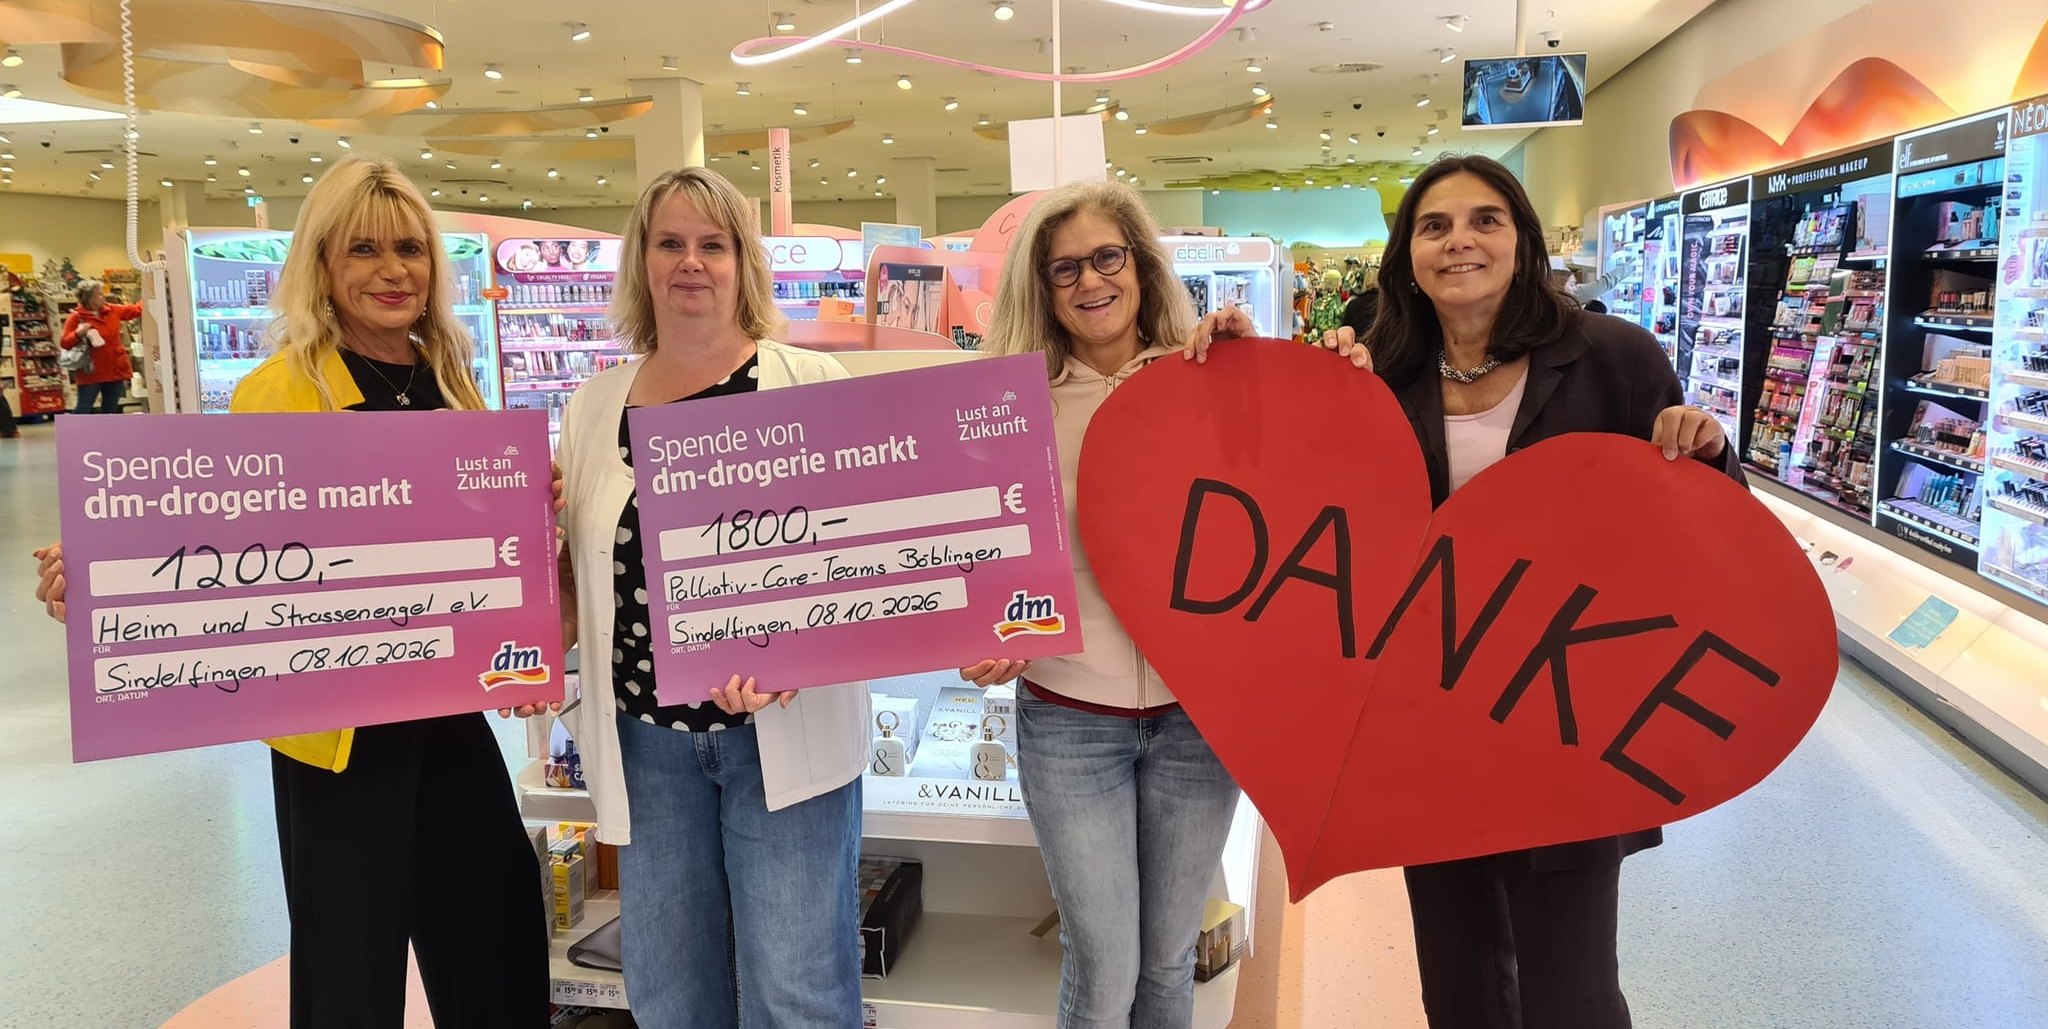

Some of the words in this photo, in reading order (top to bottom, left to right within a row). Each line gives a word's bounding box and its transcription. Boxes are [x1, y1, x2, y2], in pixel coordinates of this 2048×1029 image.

[773, 147, 783, 193] Kosmetik
[1768, 174, 1787, 194] NYX
[1792, 165, 1837, 186] PROFESSIONAL
[1840, 157, 1868, 174] MAKEUP
[1176, 244, 1225, 261] ebelin
[1688, 273, 1697, 295] YOUR
[955, 404, 988, 423] Lust
[992, 403, 1011, 419] an
[648, 427, 748, 466] Spende
[755, 419, 805, 447] von
[958, 416, 1029, 442] Zukunft
[82, 450, 213, 488] Spende
[225, 451, 284, 476] von
[455, 457, 489, 471] Lust
[492, 458, 512, 470] an
[651, 448, 826, 495] dm-drogerie
[834, 434, 919, 470] markt
[457, 470, 529, 490] Zukunft
[84, 484, 307, 522] dm-drogerie
[318, 477, 413, 508] markt
[1003, 483, 1027, 515] €
[498, 536, 521, 567] €
[897, 544, 1002, 574] Böblingen
[98, 613, 178, 644] Heim
[202, 609, 249, 636] und
[264, 593, 434, 629] Strassenengel
[666, 603, 680, 611] FÜR
[671, 616, 799, 648] Sindelfingen,
[806, 591, 943, 629] 08.10.2026
[1007, 592, 1052, 622] dm
[92, 645, 111, 655] FÜR
[288, 638, 440, 674] 08.10.2026
[494, 642, 540, 671] dm
[671, 646, 687, 654] ORT,
[687, 643, 711, 652] DATUM
[1169, 477, 1781, 806] DANKE
[95, 694, 115, 704] ORT,
[117, 690, 149, 701] DATUM
[918, 783, 1021, 802] &VANILL
[963, 803, 1013, 811] PERSÖNLICHE
